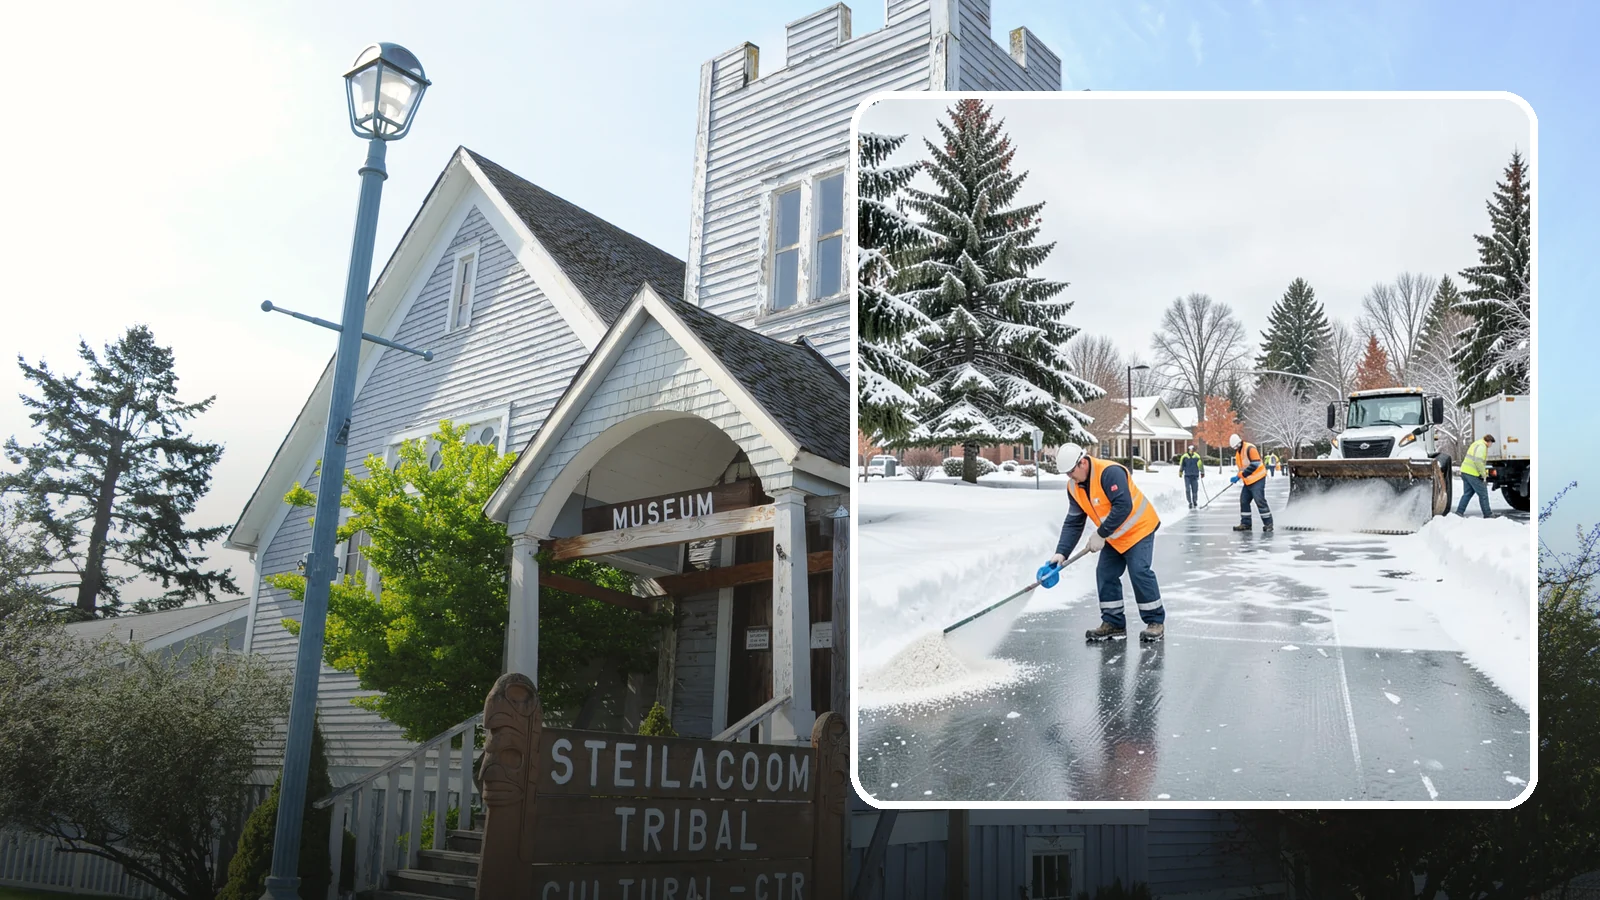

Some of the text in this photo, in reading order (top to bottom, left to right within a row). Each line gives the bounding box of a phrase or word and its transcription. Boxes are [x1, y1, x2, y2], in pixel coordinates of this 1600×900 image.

[613, 491, 714, 530] MUSEUM
[551, 738, 809, 792] STEILACOOM
[615, 807, 757, 851] TRIBAL
